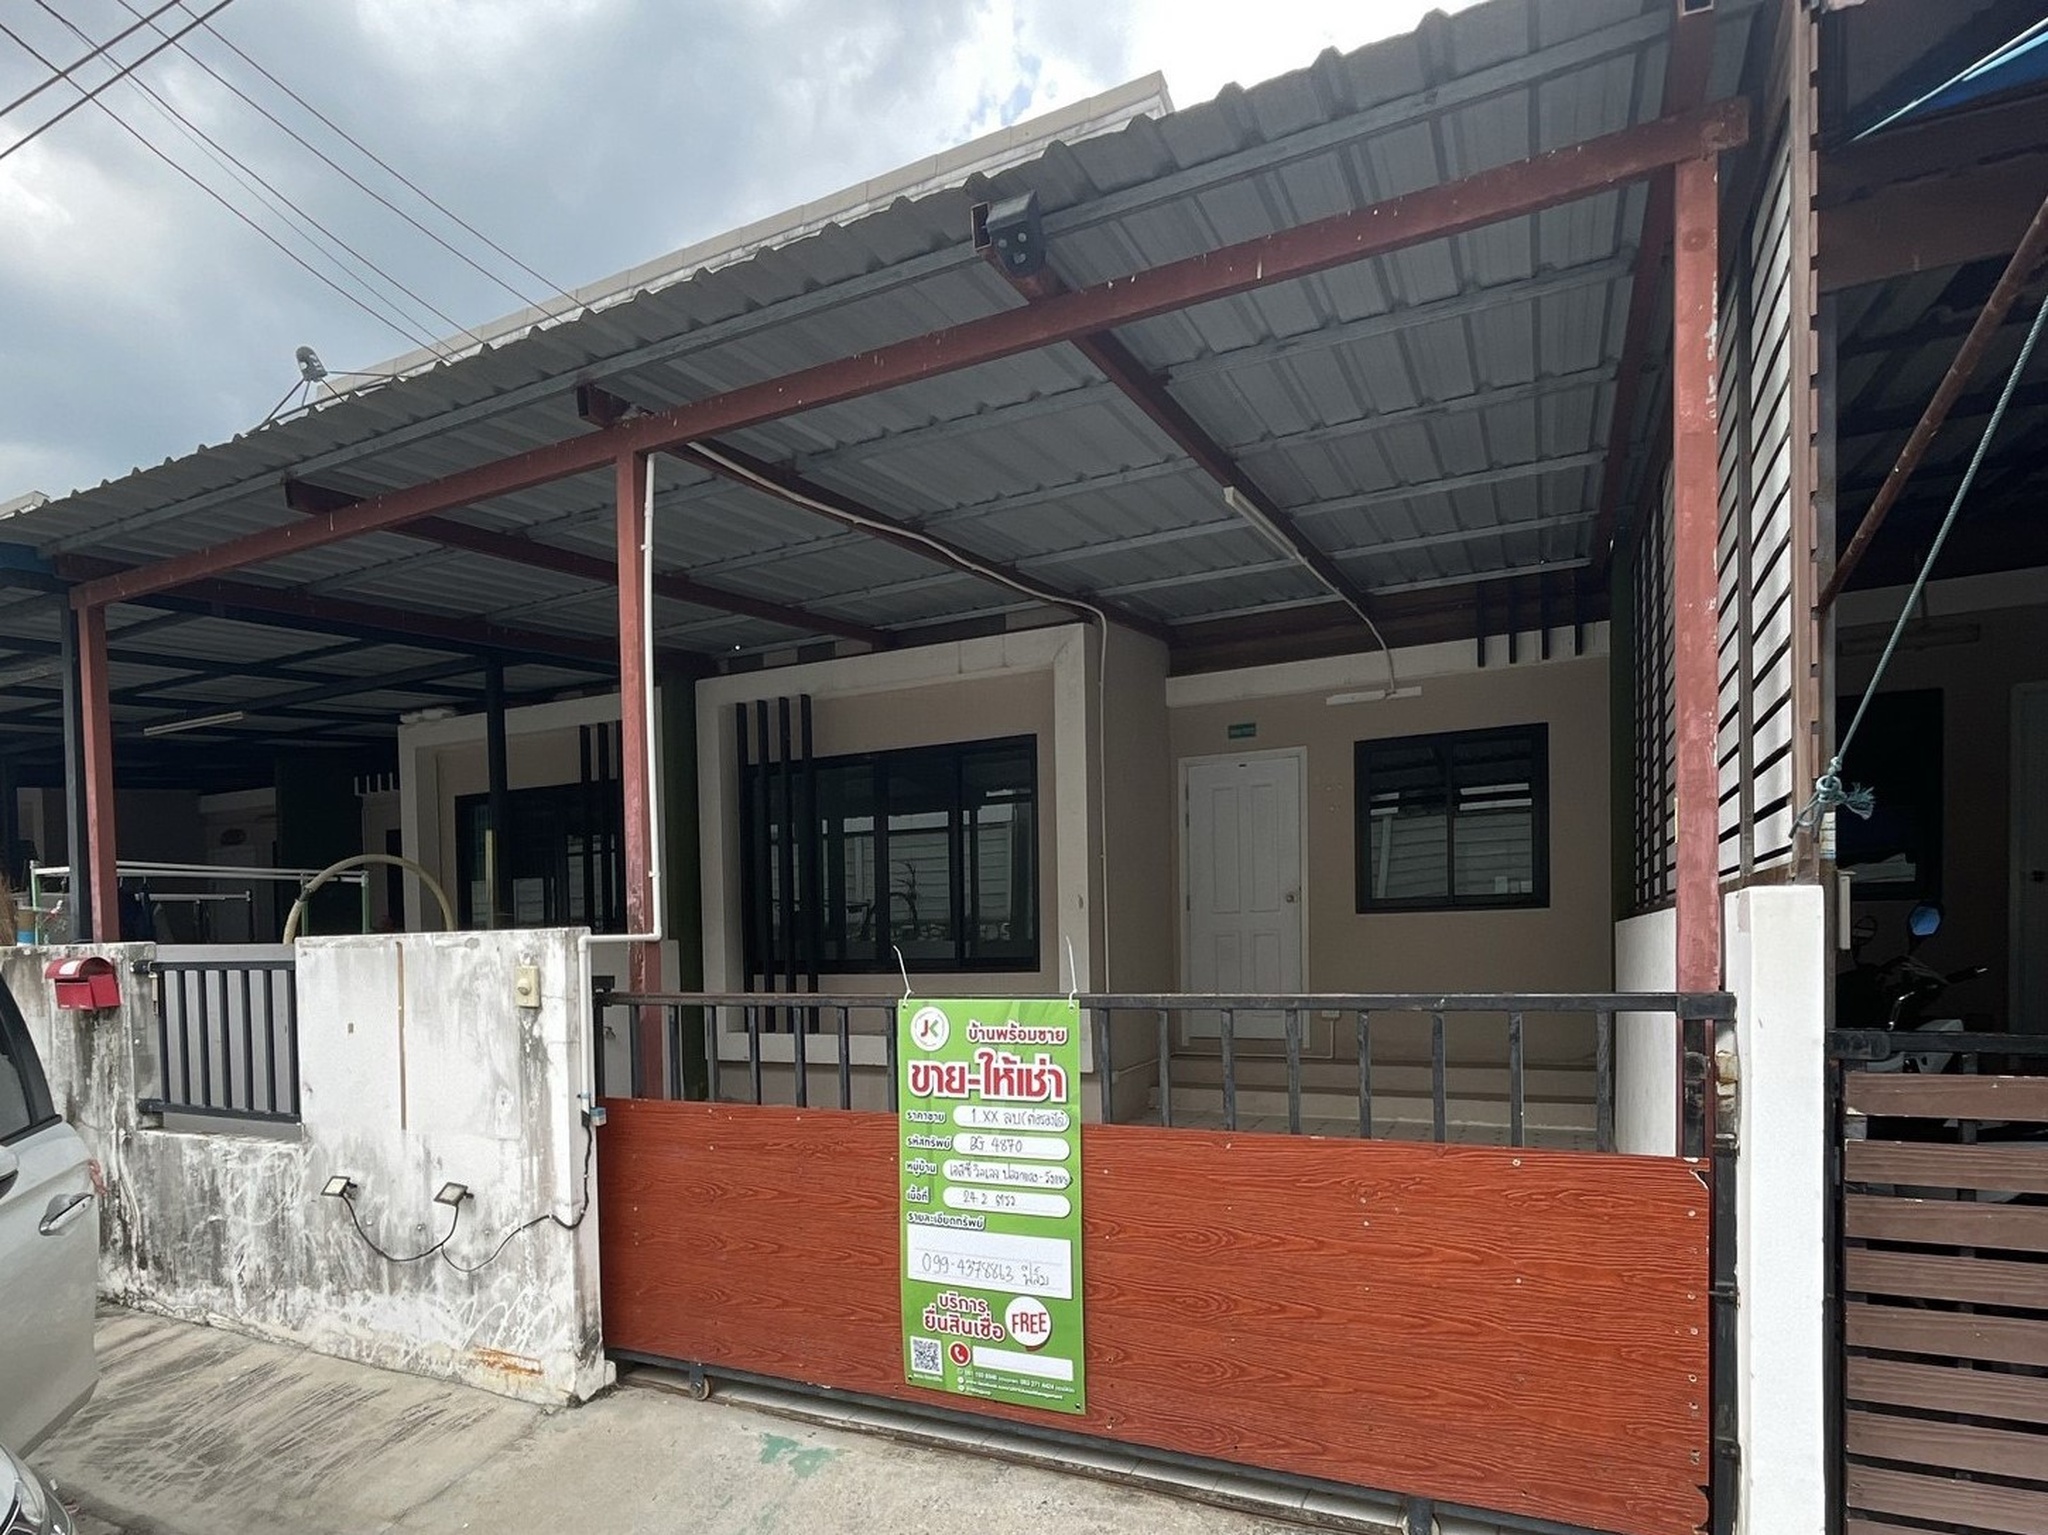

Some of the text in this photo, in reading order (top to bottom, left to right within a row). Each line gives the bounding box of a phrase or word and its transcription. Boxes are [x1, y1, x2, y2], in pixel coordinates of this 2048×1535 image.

[911, 1051, 1064, 1099] ขาย-ให้เช่า
[991, 1137, 1023, 1153] 4870
[907, 1159, 936, 1175] หมู่บ้าน
[908, 1212, 984, 1229] รายละเอียดทรัพย์
[939, 1294, 987, 1313] บริการ
[924, 1305, 1004, 1340] ยื่นสินเชื่อ
[1011, 1312, 1048, 1335] FREE
